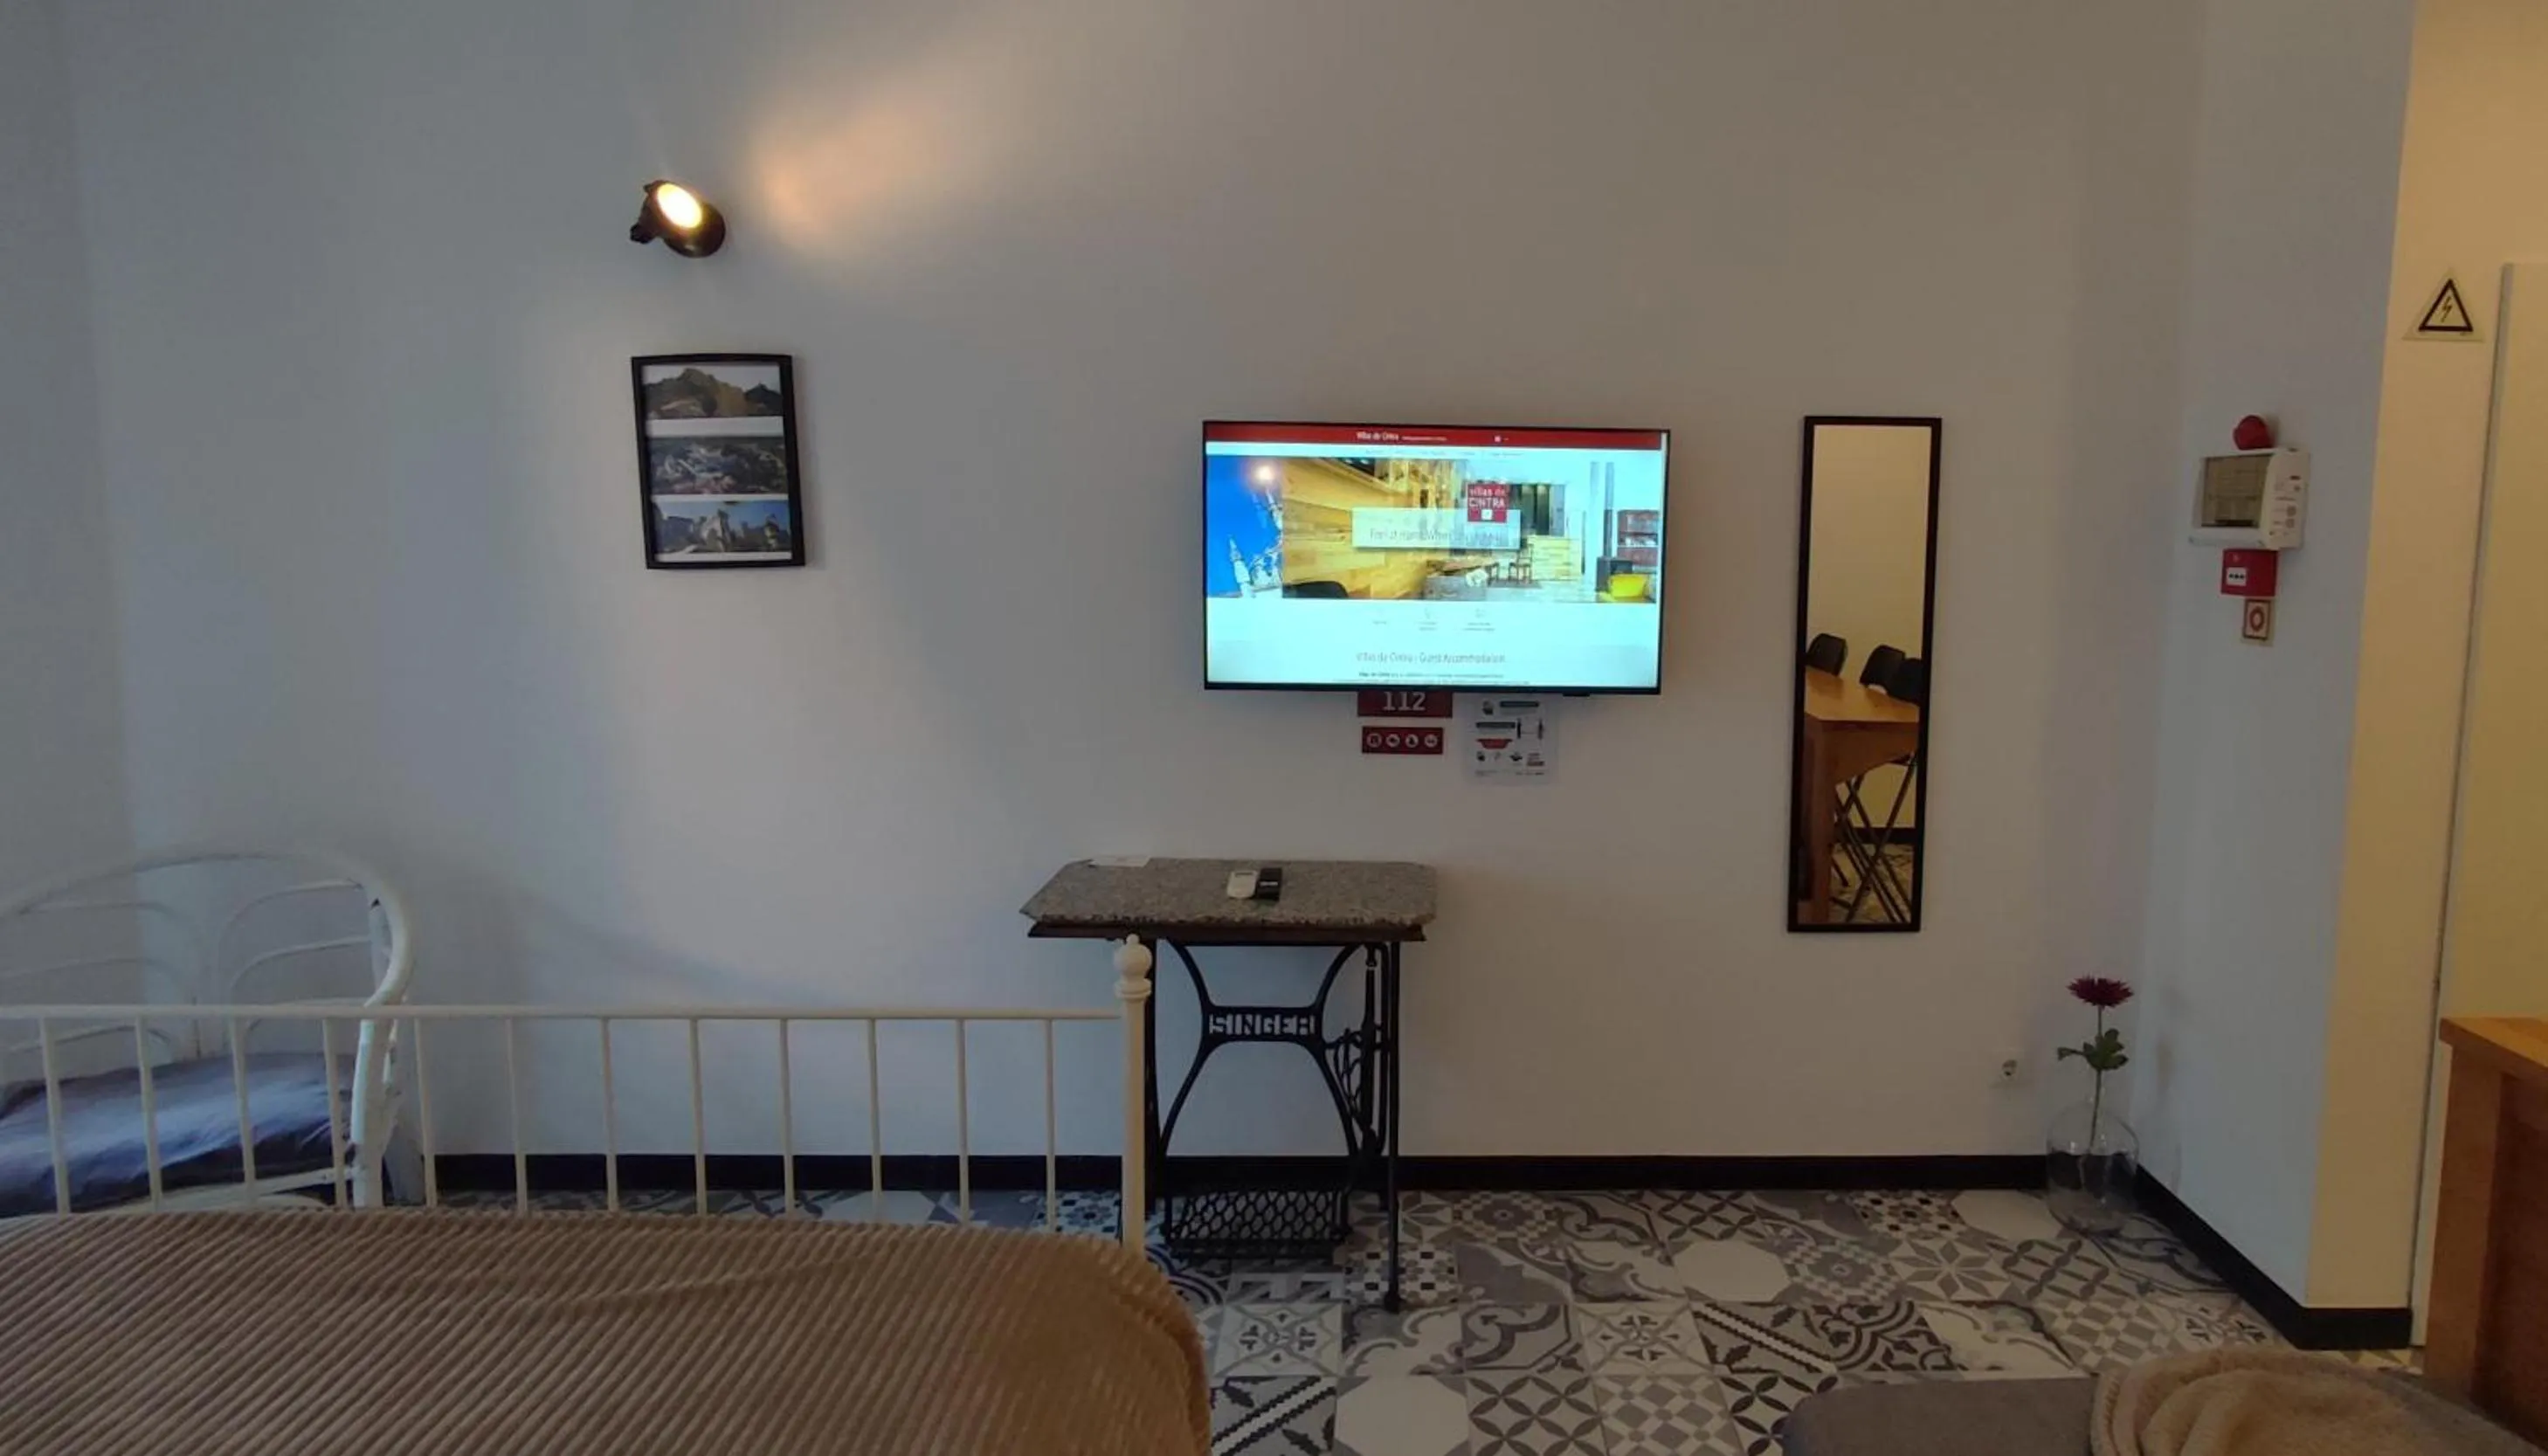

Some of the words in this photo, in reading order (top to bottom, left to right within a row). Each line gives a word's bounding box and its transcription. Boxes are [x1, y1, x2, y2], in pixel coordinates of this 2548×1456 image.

[1468, 497, 1506, 508] CINTRA
[1383, 691, 1426, 711] 112
[1209, 1013, 1315, 1036] SINGER
